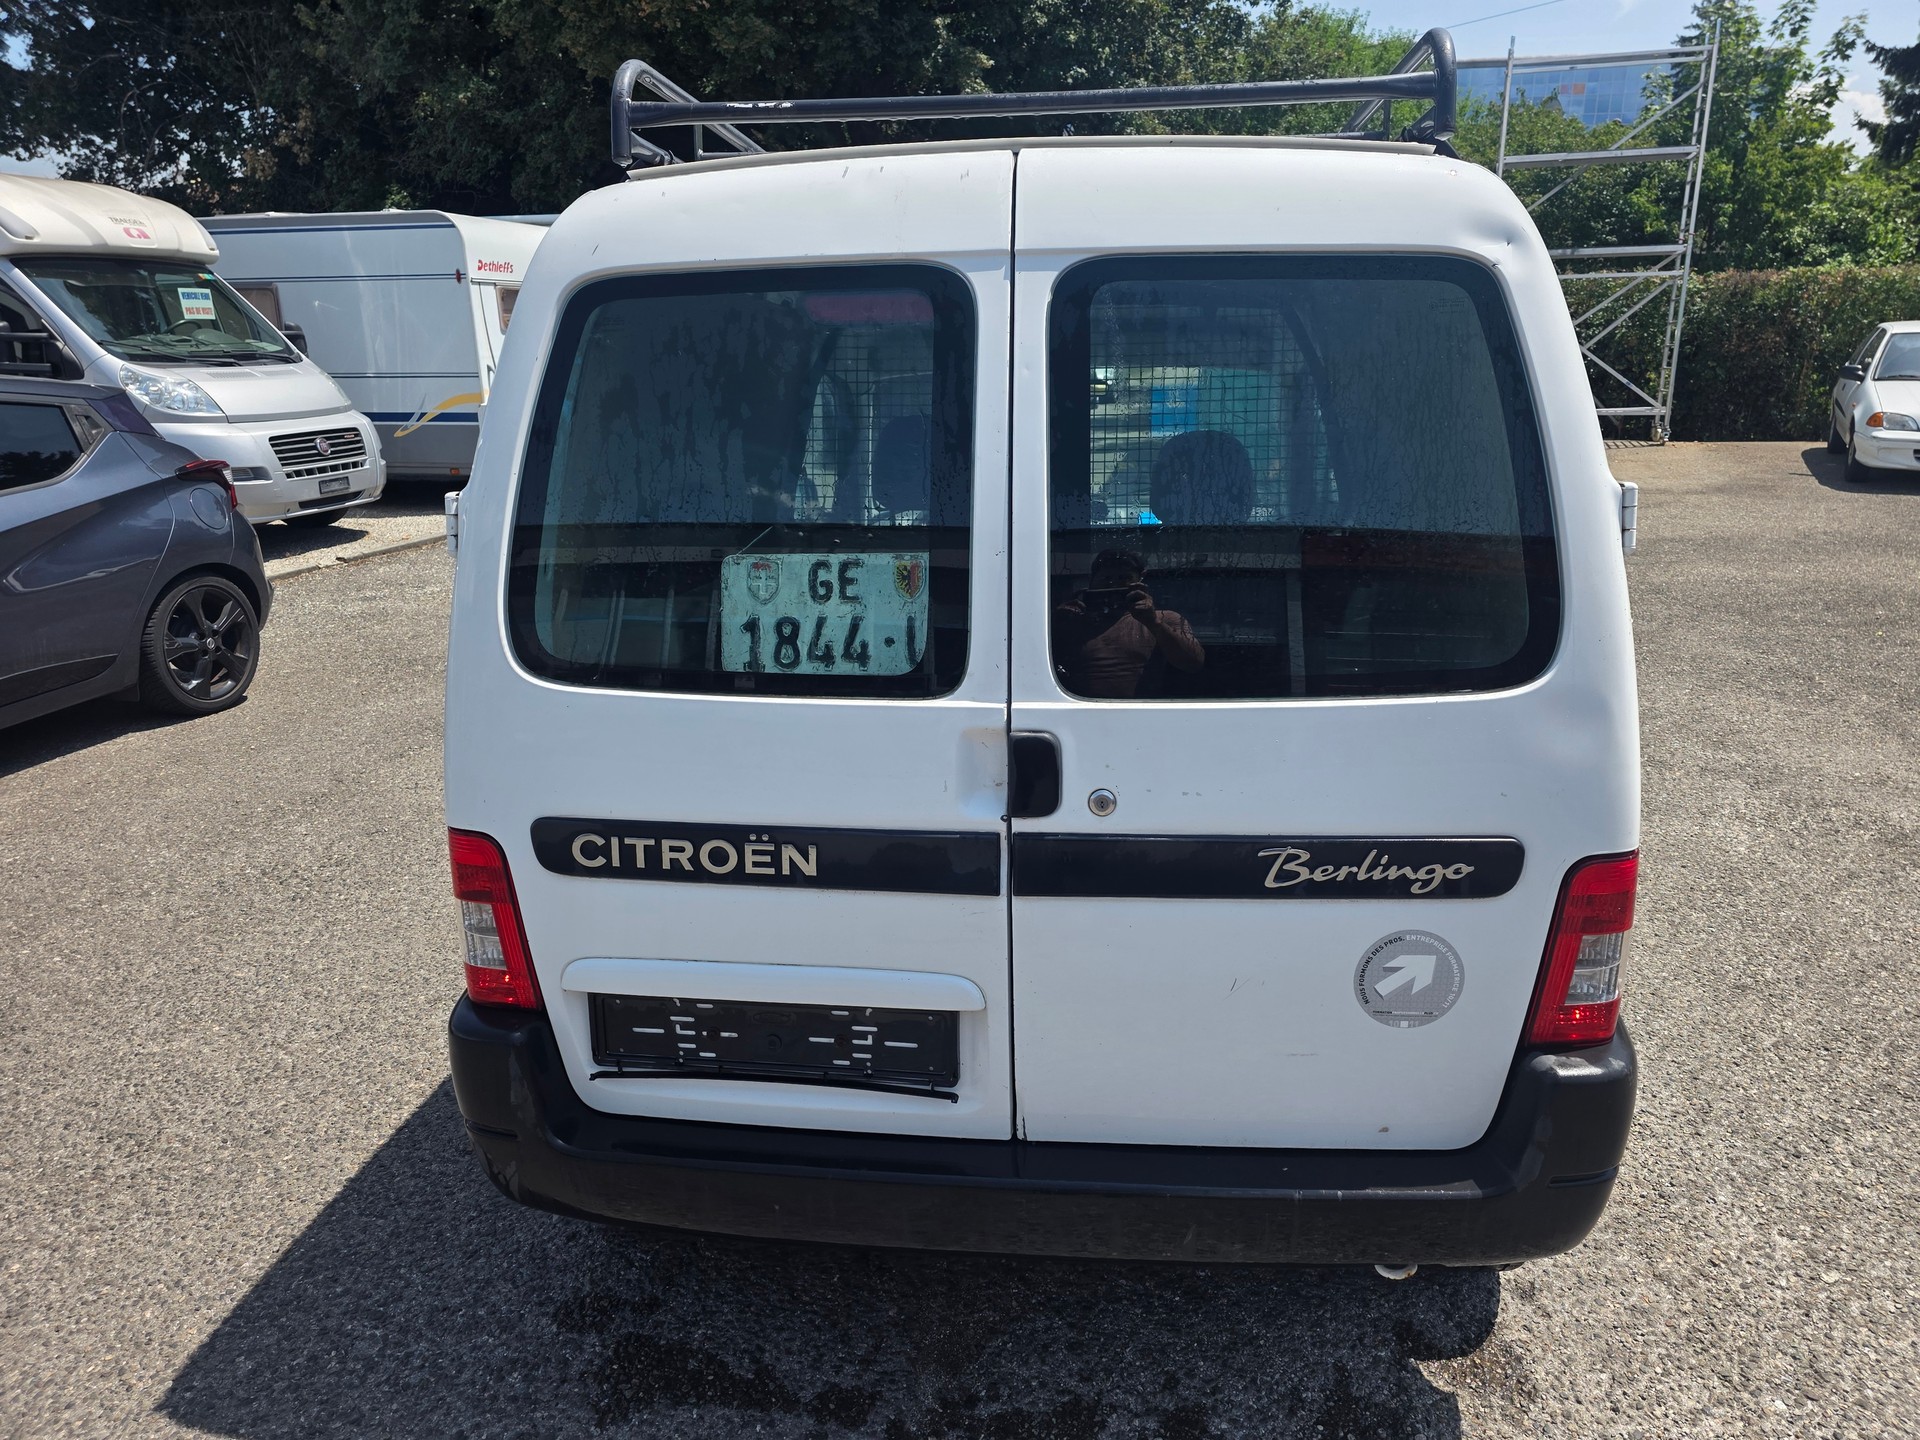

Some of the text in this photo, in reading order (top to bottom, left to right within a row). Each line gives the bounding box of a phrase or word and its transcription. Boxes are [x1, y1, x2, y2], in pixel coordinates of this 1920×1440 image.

[477, 259, 513, 273] Dethleffs
[808, 559, 865, 604] GE
[571, 833, 817, 877] CITROËN
[1257, 846, 1475, 894] Berlingo
[1358, 934, 1460, 1009] NOUS FORMONS DES PROS. ENTREPRISE FORMATRICE 10/11
